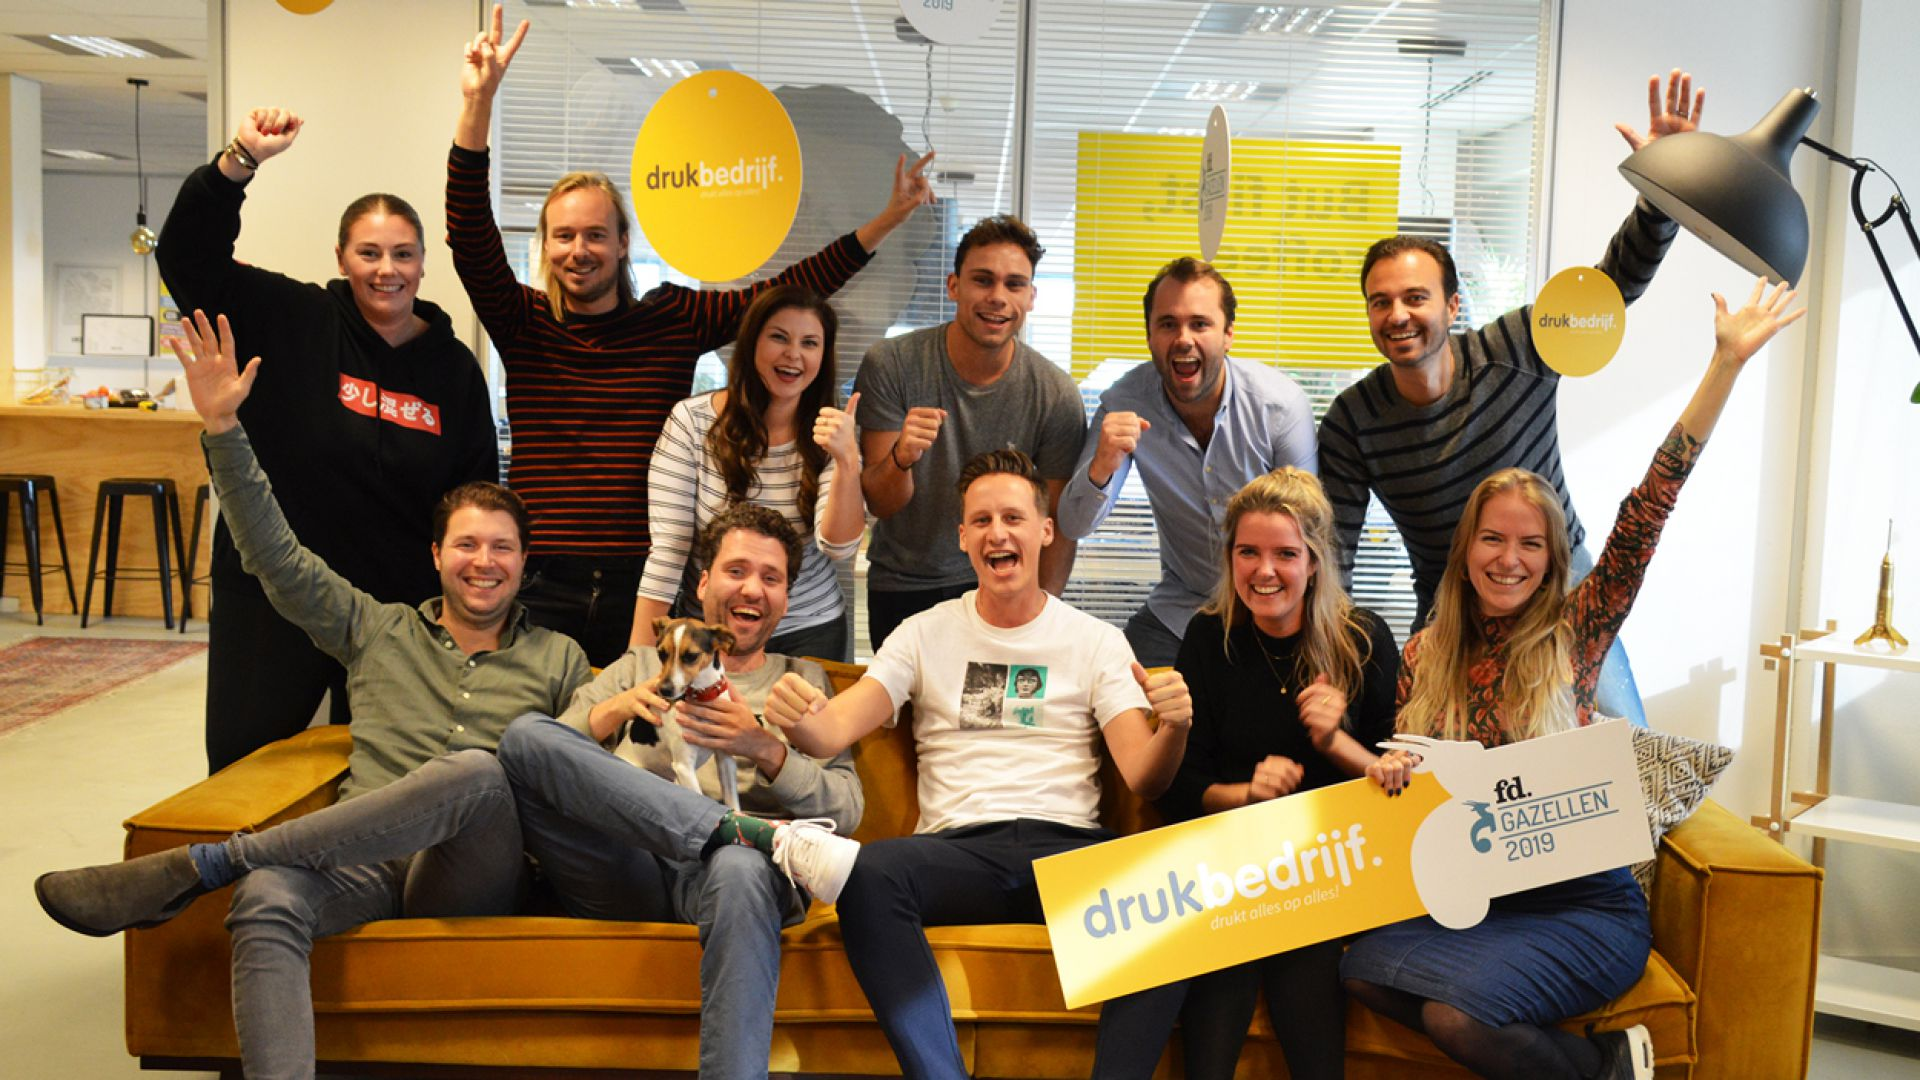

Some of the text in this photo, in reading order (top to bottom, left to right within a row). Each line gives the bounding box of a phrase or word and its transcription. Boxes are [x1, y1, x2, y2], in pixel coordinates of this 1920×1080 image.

[646, 154, 784, 190] drukbedrijf.
[1538, 312, 1617, 332] drukbedrijf.
[341, 382, 436, 427] 少し混ぜる
[1494, 775, 1532, 804] fd.
[1501, 789, 1609, 832] GAZELLEN
[1505, 832, 1555, 861] 2019
[1083, 823, 1383, 938] drukbedrijf.
[1210, 884, 1340, 930] drukt alles op alles!
